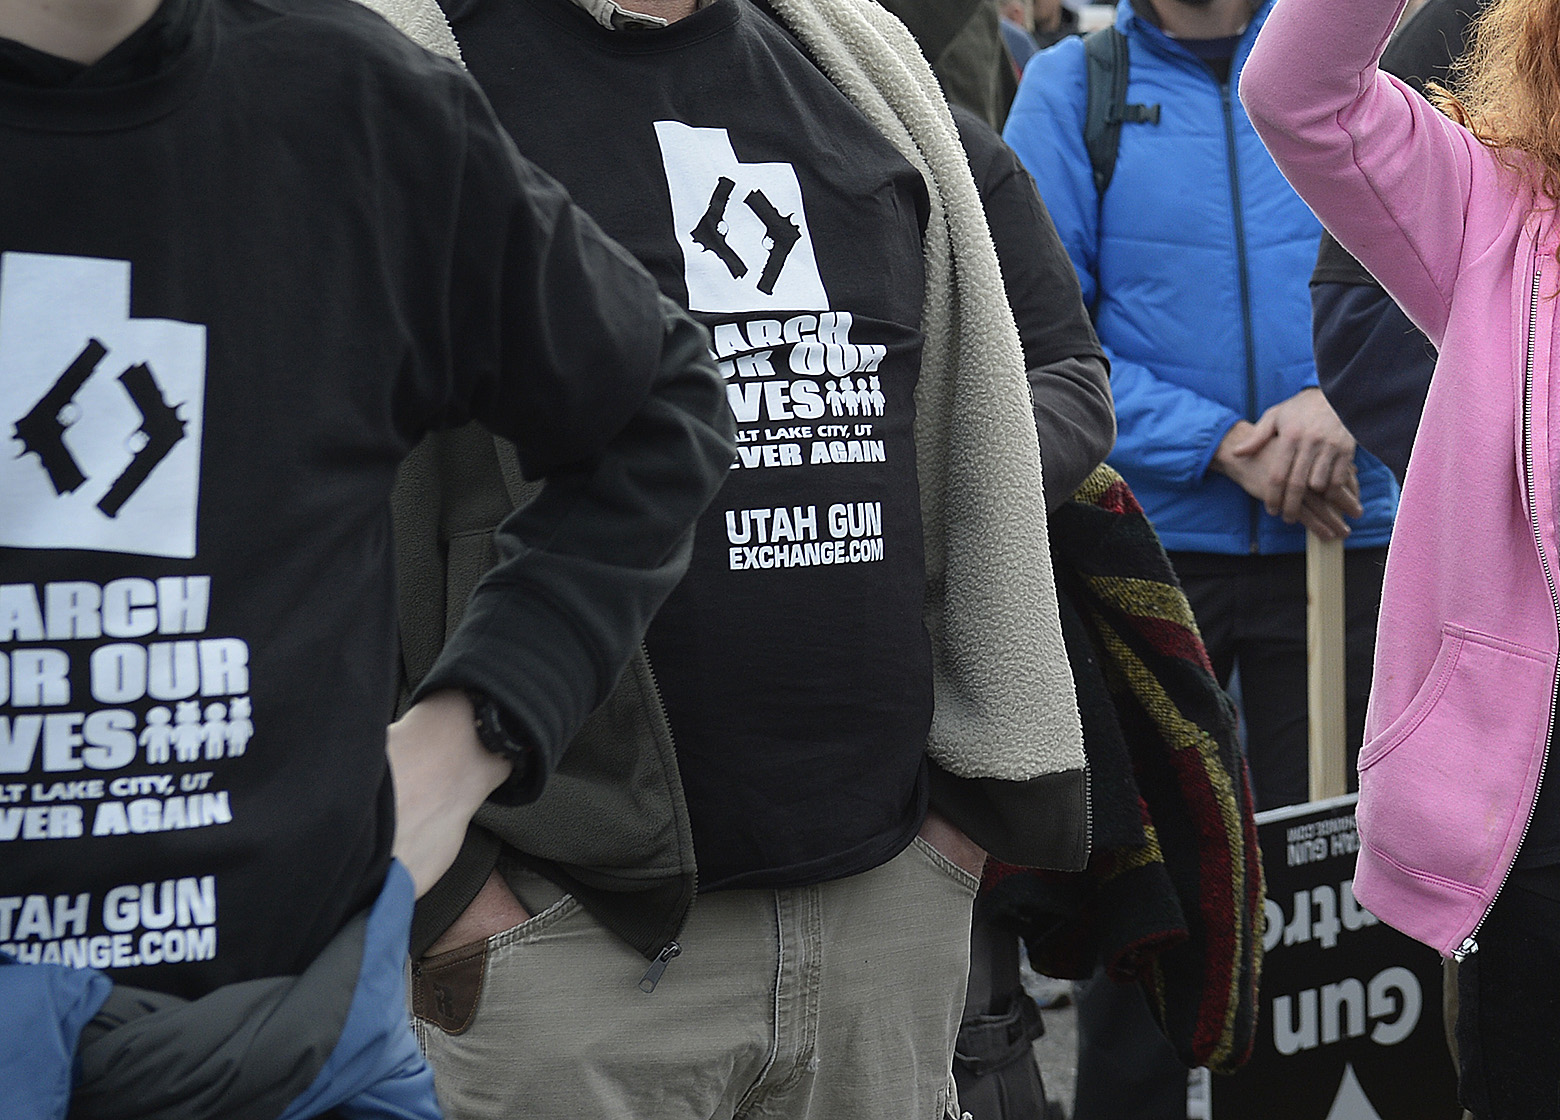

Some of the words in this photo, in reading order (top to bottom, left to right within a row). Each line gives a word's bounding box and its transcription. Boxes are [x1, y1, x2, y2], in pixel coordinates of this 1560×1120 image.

[765, 426, 812, 441] LAKE
[817, 425, 851, 439] CITY,
[855, 424, 873, 437] UT
[810, 440, 887, 465] AGAIN
[725, 505, 817, 545] UTAH
[828, 502, 882, 539] GUN
[729, 538, 884, 570] EXCHANGE.COM
[90, 638, 250, 704] OUR
[31, 780, 104, 802] LAKE
[180, 771, 214, 791] UT
[92, 791, 233, 838] AGAIN
[103, 875, 217, 932] GUN
[1272, 966, 1423, 1056] Gun
